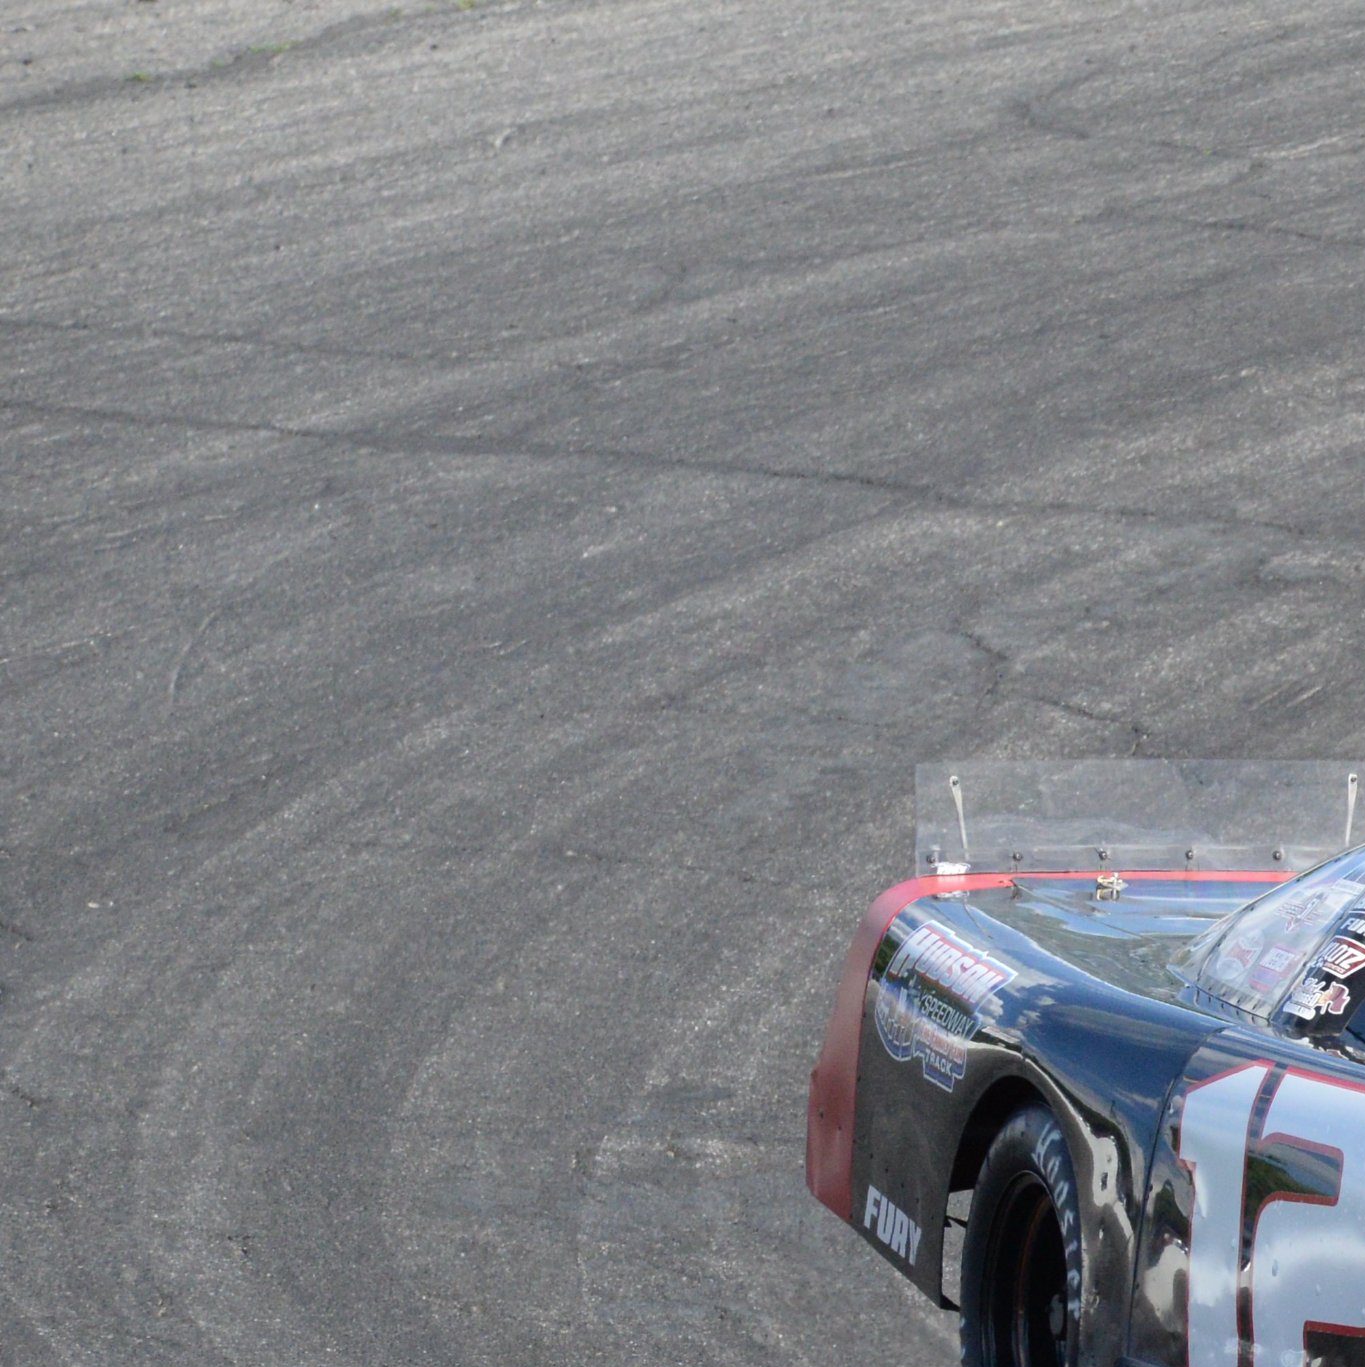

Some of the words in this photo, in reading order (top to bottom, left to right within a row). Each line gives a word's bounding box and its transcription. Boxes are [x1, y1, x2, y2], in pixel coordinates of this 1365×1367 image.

[889, 927, 1006, 1004] HUDSON
[920, 994, 976, 1037] SPEEDWAY
[925, 1049, 953, 1076] TRACK
[863, 1184, 922, 1267] FURY
